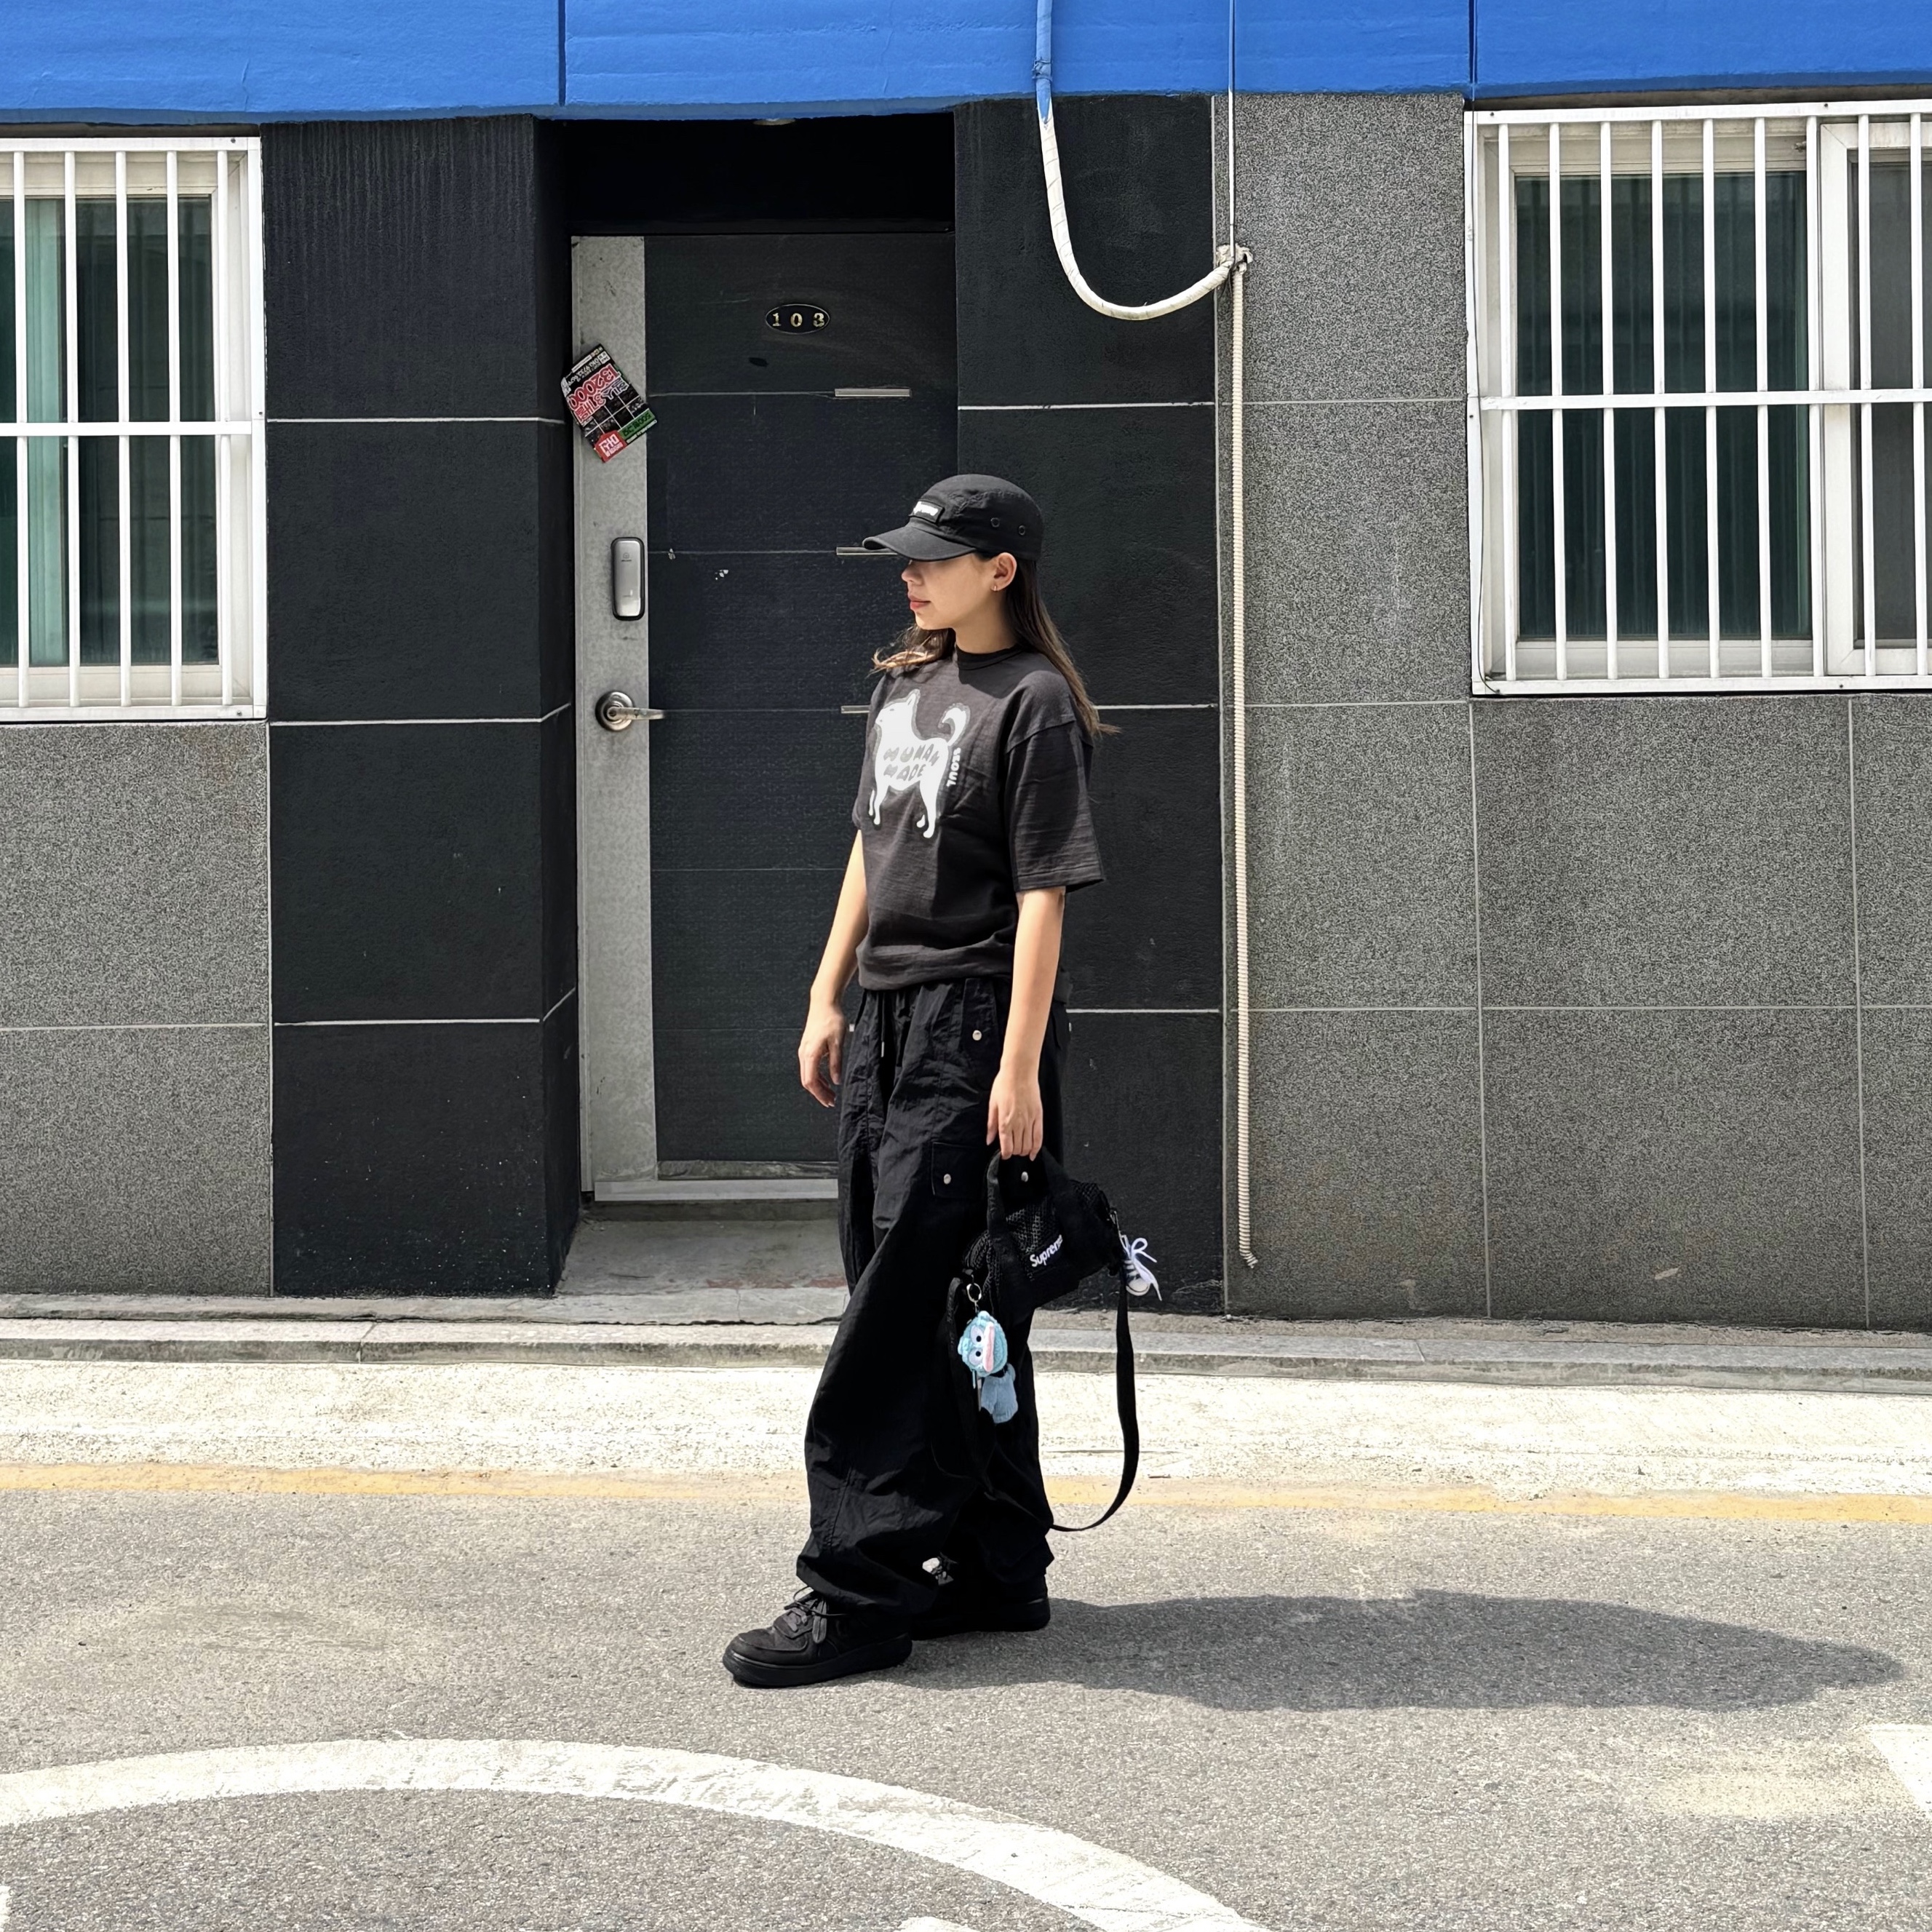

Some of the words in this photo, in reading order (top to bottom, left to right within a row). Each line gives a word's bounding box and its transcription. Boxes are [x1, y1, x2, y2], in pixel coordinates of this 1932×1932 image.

[772, 312, 825, 327] 103
[568, 364, 621, 410] 132000
[883, 744, 939, 766] HUMAN
[883, 764, 926, 782] MADE
